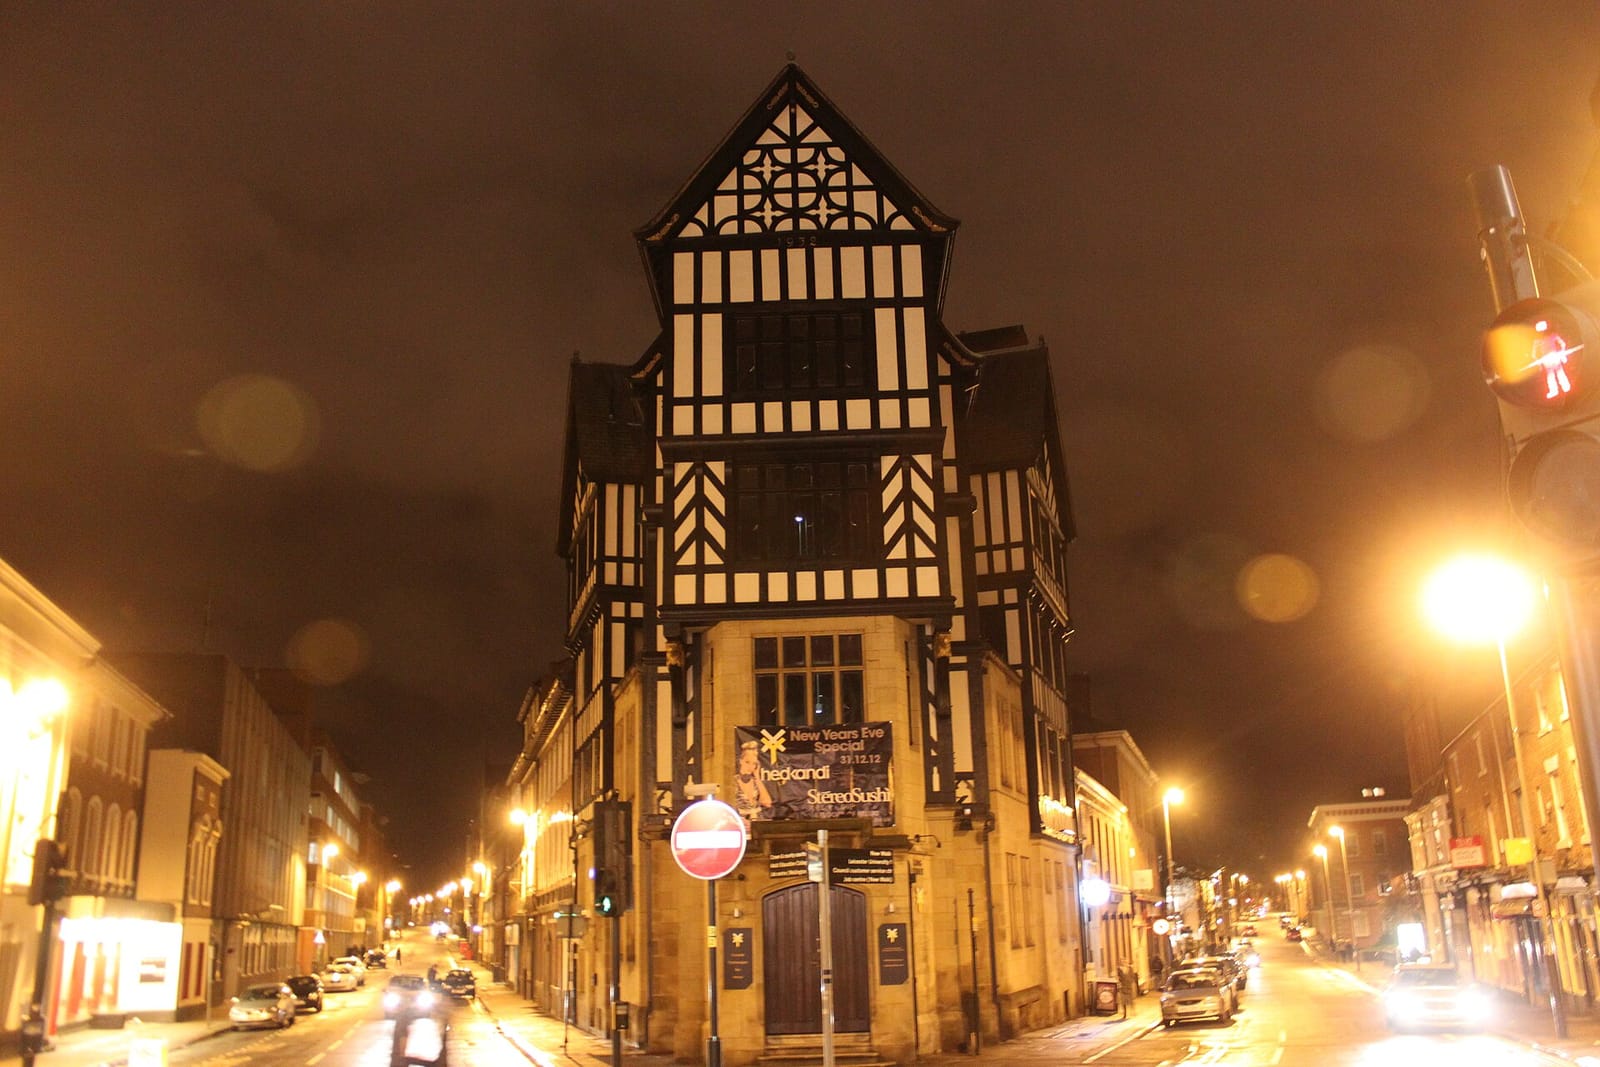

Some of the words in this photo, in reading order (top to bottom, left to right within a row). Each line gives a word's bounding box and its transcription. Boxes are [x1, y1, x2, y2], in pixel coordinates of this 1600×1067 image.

[790, 730, 820, 742] New
[822, 729, 859, 741] Years
[861, 727, 885, 739] Eve
[814, 739, 865, 754] Special
[839, 754, 881, 765] 31.12.12
[760, 765, 830, 782] hedkandi
